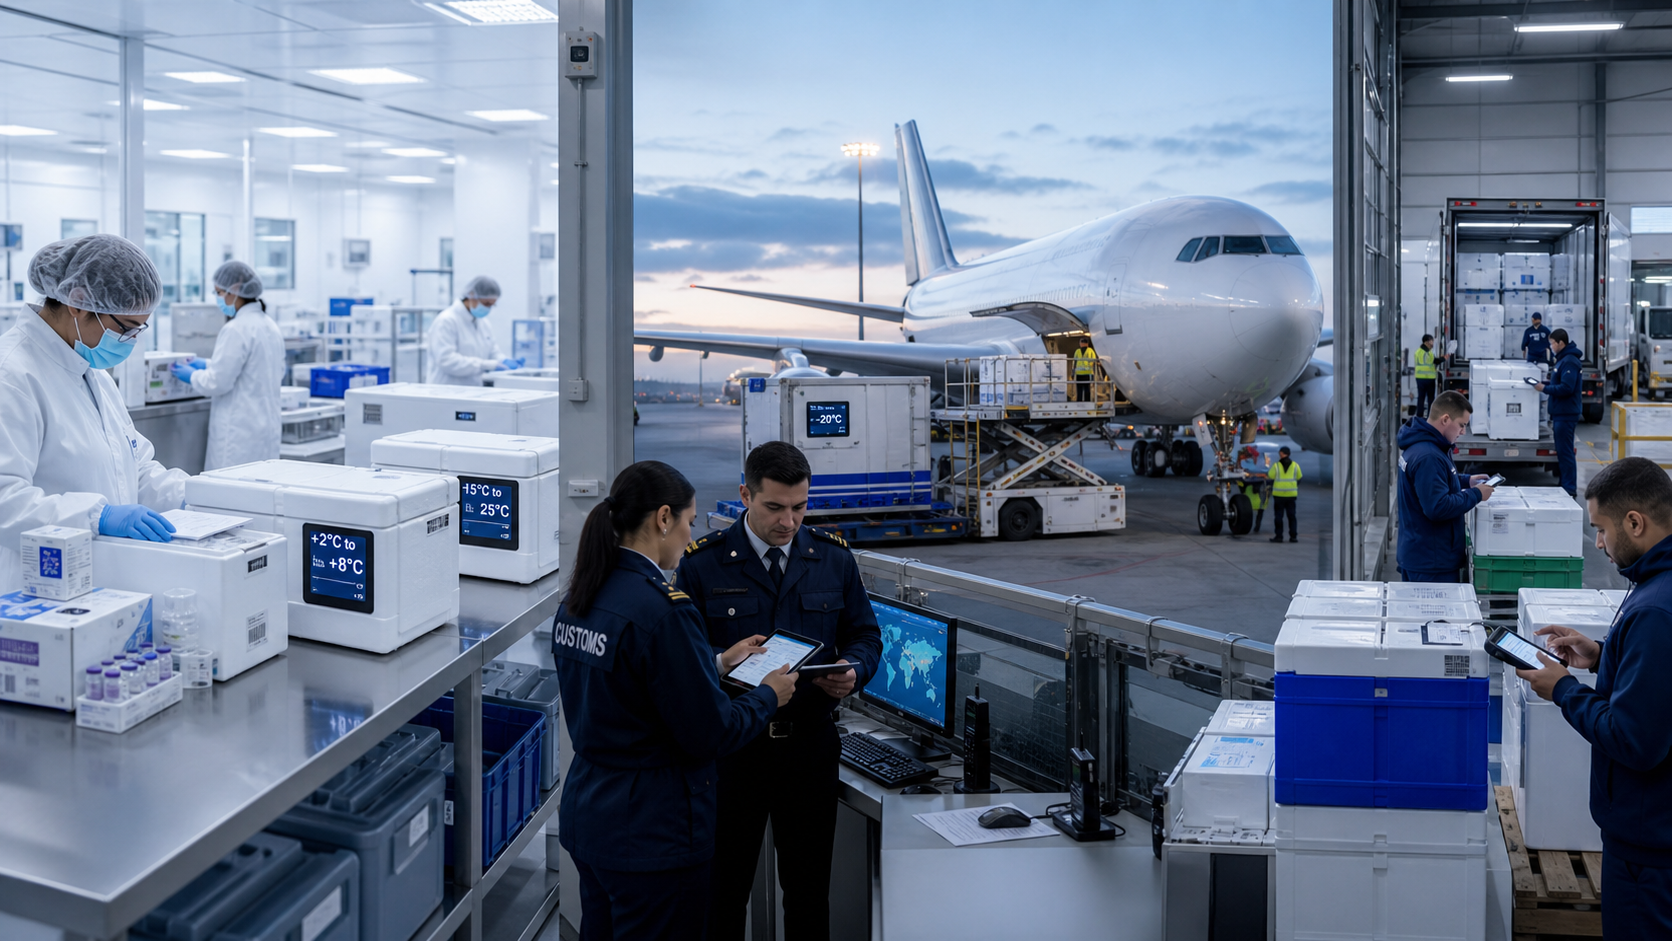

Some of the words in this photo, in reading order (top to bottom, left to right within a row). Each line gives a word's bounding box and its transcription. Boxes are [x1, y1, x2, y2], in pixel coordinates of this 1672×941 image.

[492, 487, 502, 498] to
[480, 503, 510, 518] 25°C
[311, 532, 342, 549] +2°C
[344, 538, 356, 551] to
[329, 557, 364, 575] +8°C
[555, 621, 608, 657] CUSTOMS
